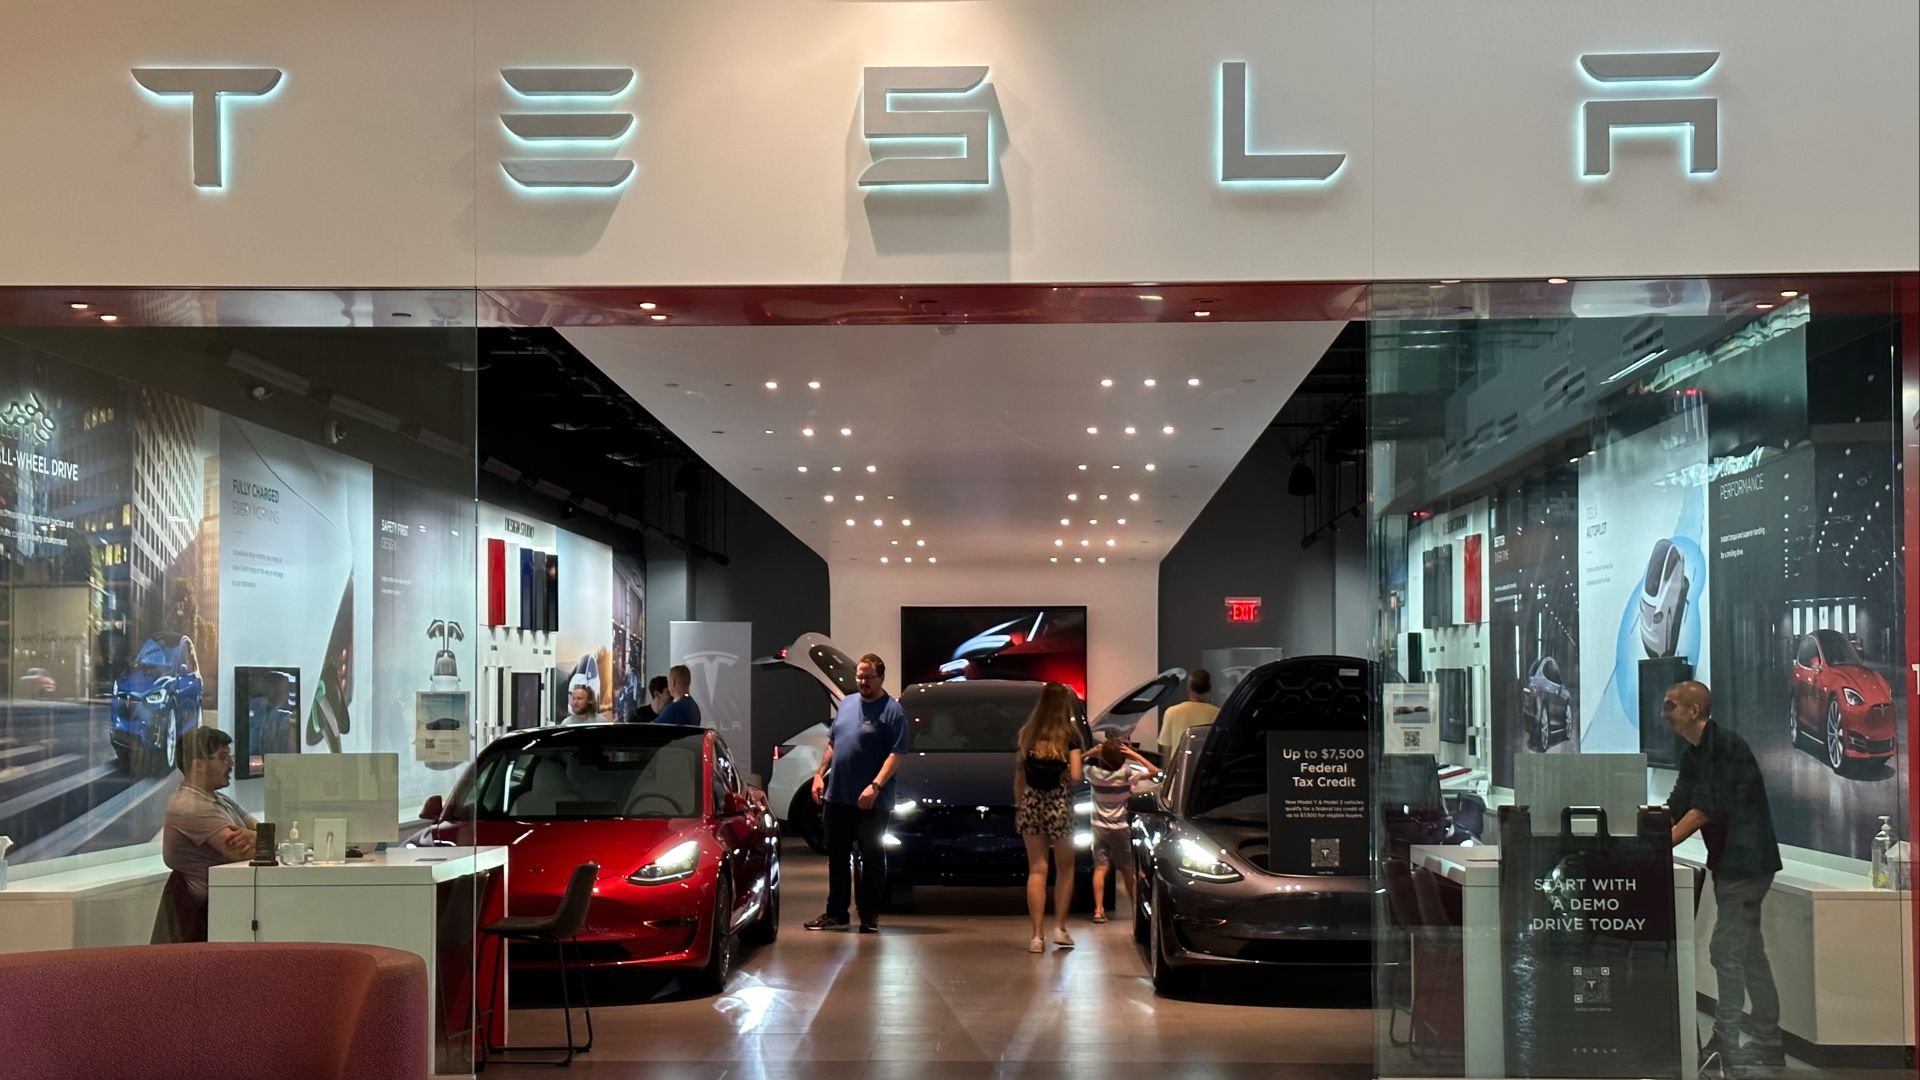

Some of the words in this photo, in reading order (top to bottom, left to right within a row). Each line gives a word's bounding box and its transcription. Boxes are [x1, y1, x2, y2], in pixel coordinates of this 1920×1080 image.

[131, 51, 1721, 193] TESLA
[0, 446, 50, 475] LL-WHEEL
[51, 457, 79, 481] DRIVE
[232, 479, 251, 496] FULLY
[252, 483, 280, 503] CHARGED
[1720, 472, 1765, 501] PERFORMANCE
[381, 519, 397, 534] SAFETY
[397, 523, 409, 536] FIRST
[504, 516, 520, 535] DESIGN
[1586, 521, 1608, 539] AUTOPILOT
[1233, 604, 1255, 620] EXIT
[1283, 748, 1300, 760] Up
[1304, 749, 1318, 759] to
[1321, 748, 1364, 760] $7,500
[1300, 762, 1347, 773] Federal
[1292, 776, 1314, 787] Tax
[1317, 776, 1356, 787] Credit
[1534, 879, 1586, 891] START
[1592, 879, 1636, 891] WITH
[1553, 899, 1564, 910] A
[1570, 899, 1620, 910] DEMO
[1533, 918, 1584, 931] DRIVE
[1589, 918, 1646, 931] TODAY
